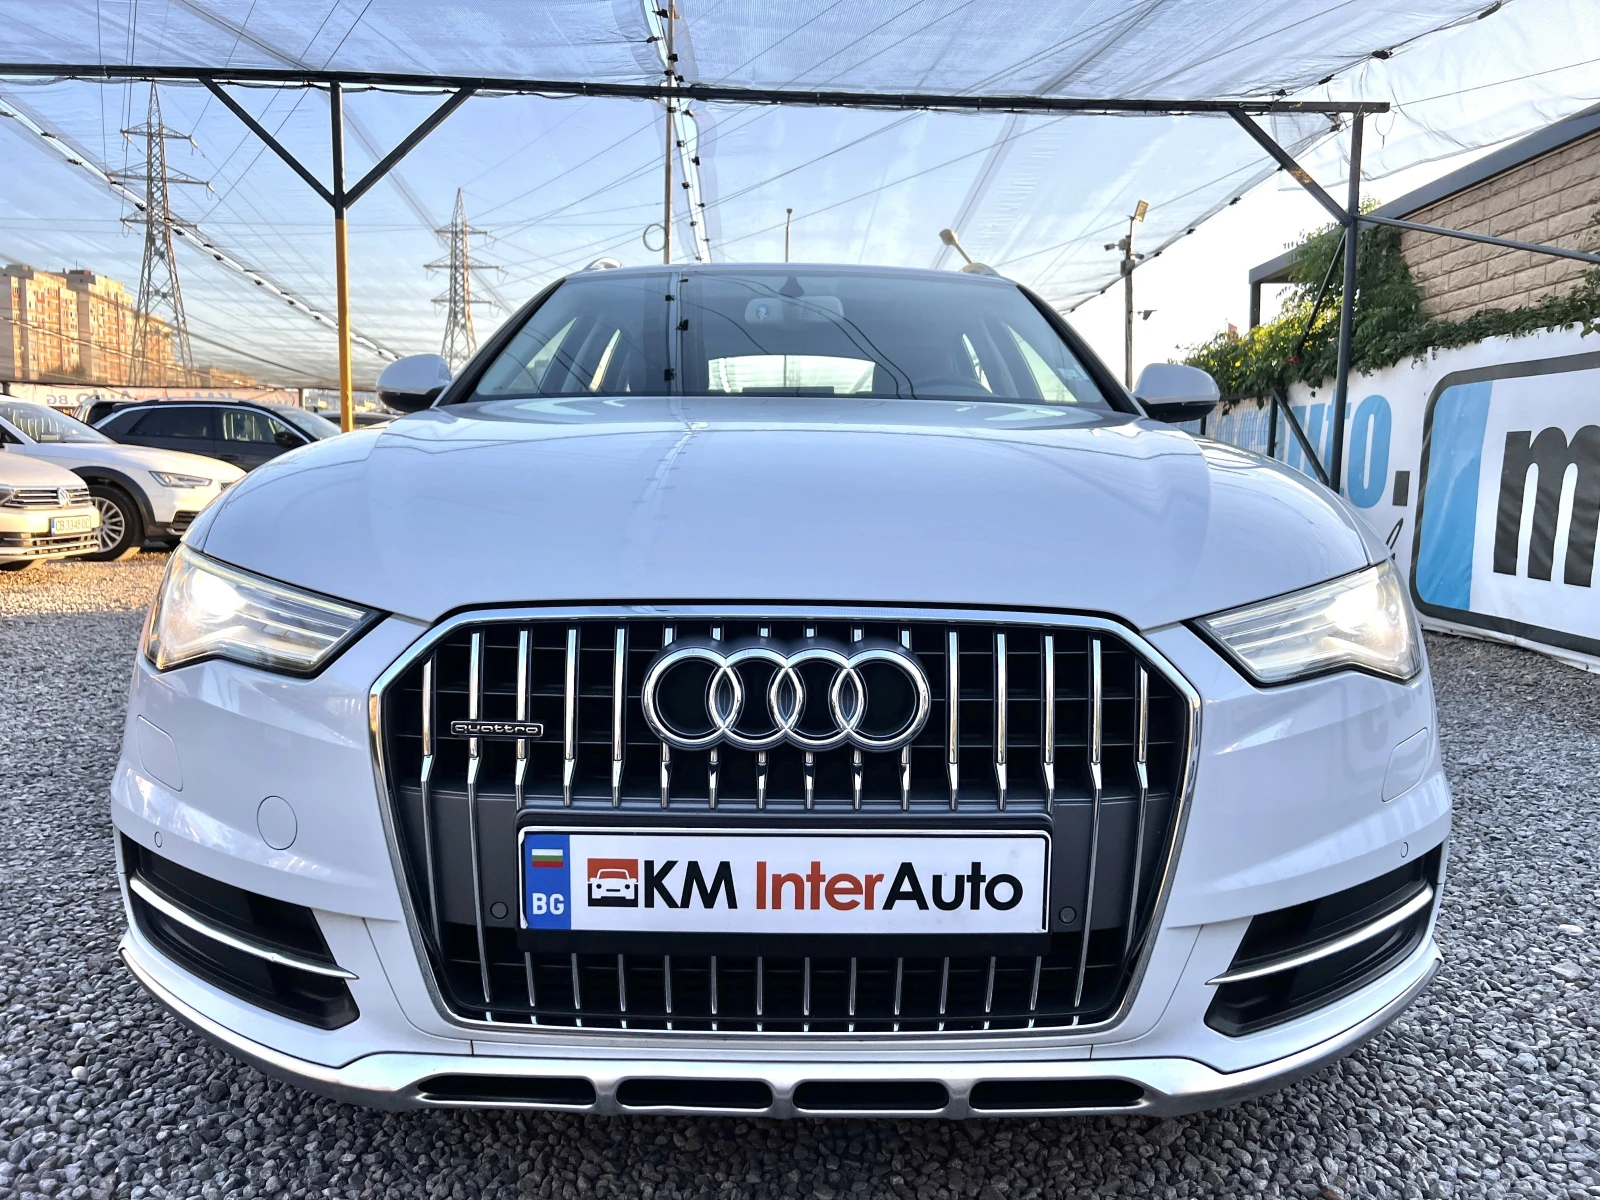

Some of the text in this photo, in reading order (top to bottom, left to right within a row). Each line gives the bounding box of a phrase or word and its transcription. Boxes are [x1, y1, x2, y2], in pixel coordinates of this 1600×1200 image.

[454, 724, 539, 734] quattro
[644, 860, 1024, 910] KM InterAuto
[532, 892, 565, 915] BG
